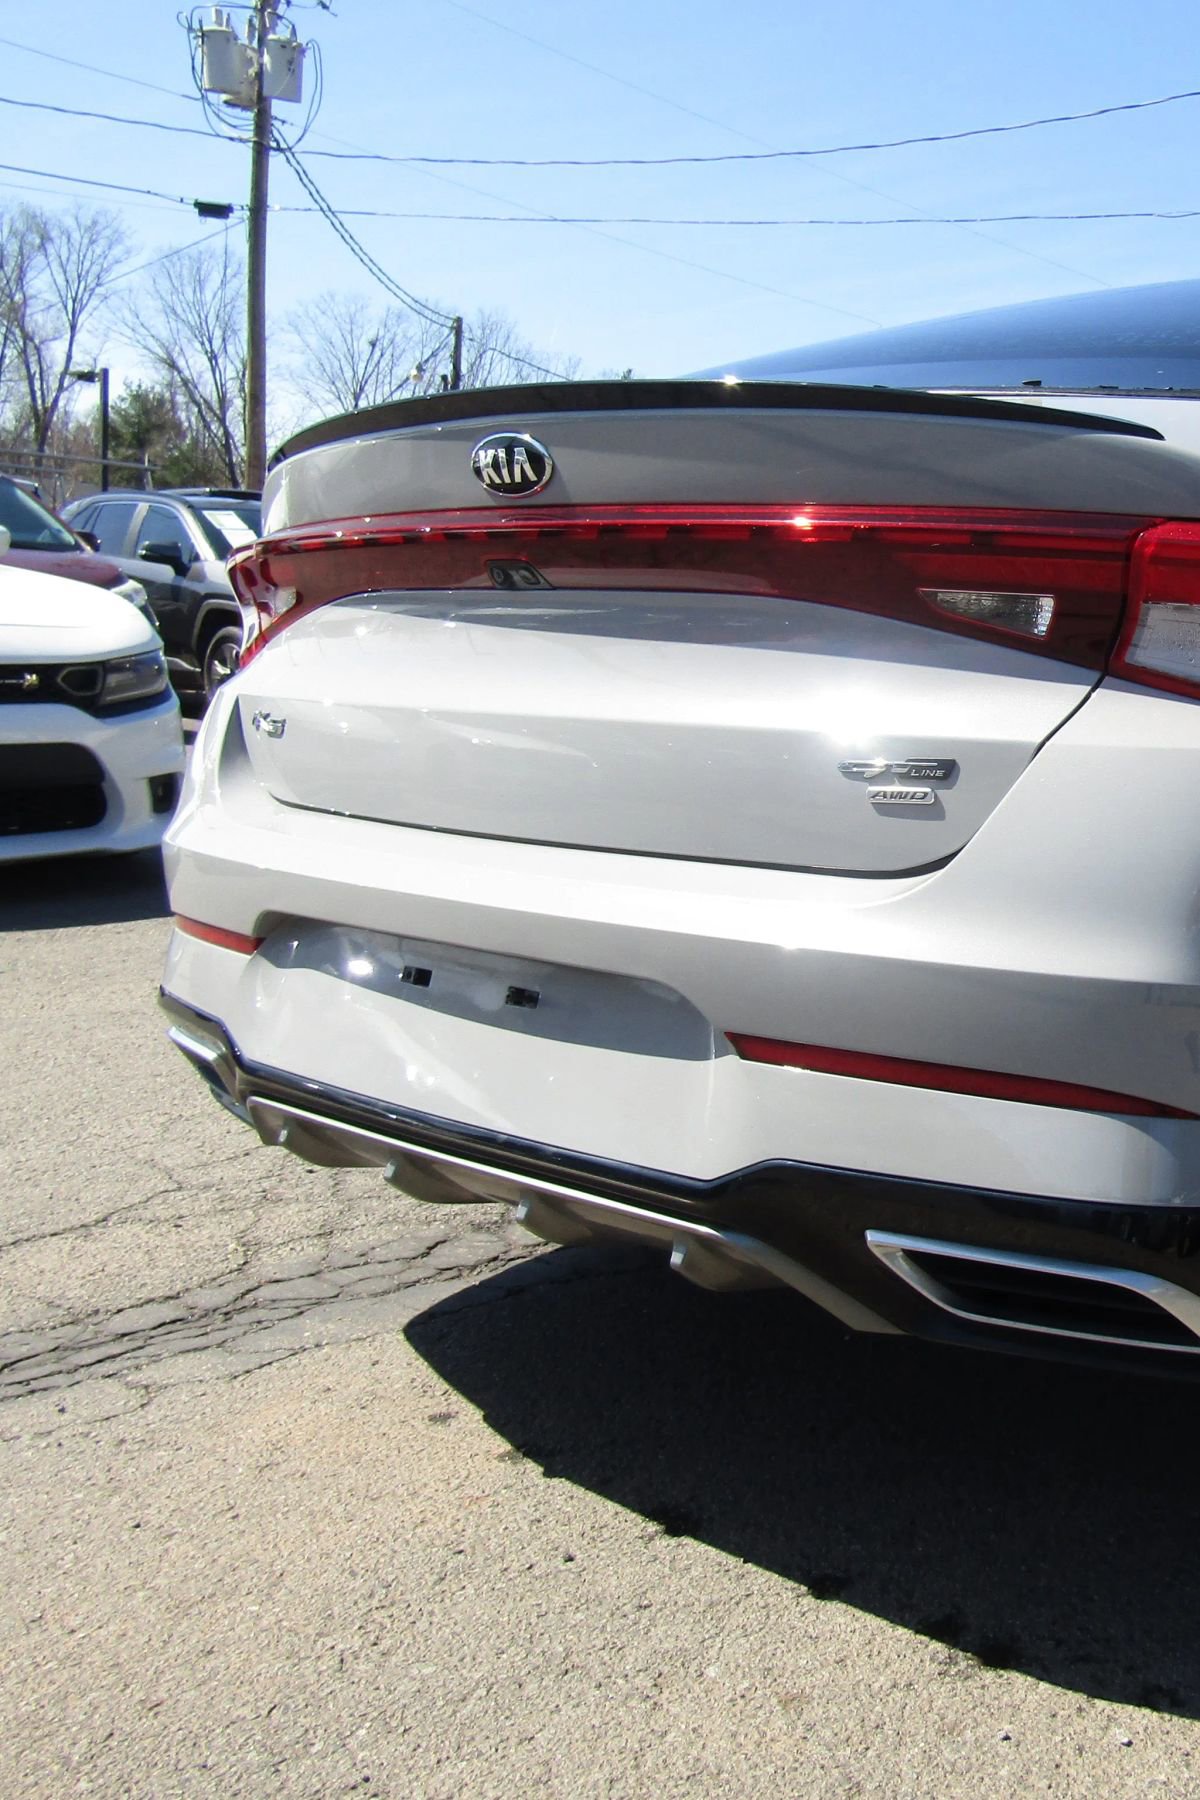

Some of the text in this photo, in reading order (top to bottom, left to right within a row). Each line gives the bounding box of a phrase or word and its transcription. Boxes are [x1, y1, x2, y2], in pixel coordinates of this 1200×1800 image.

[478, 446, 538, 484] KIA
[910, 768, 946, 778] LINE
[869, 789, 930, 801] AWD
